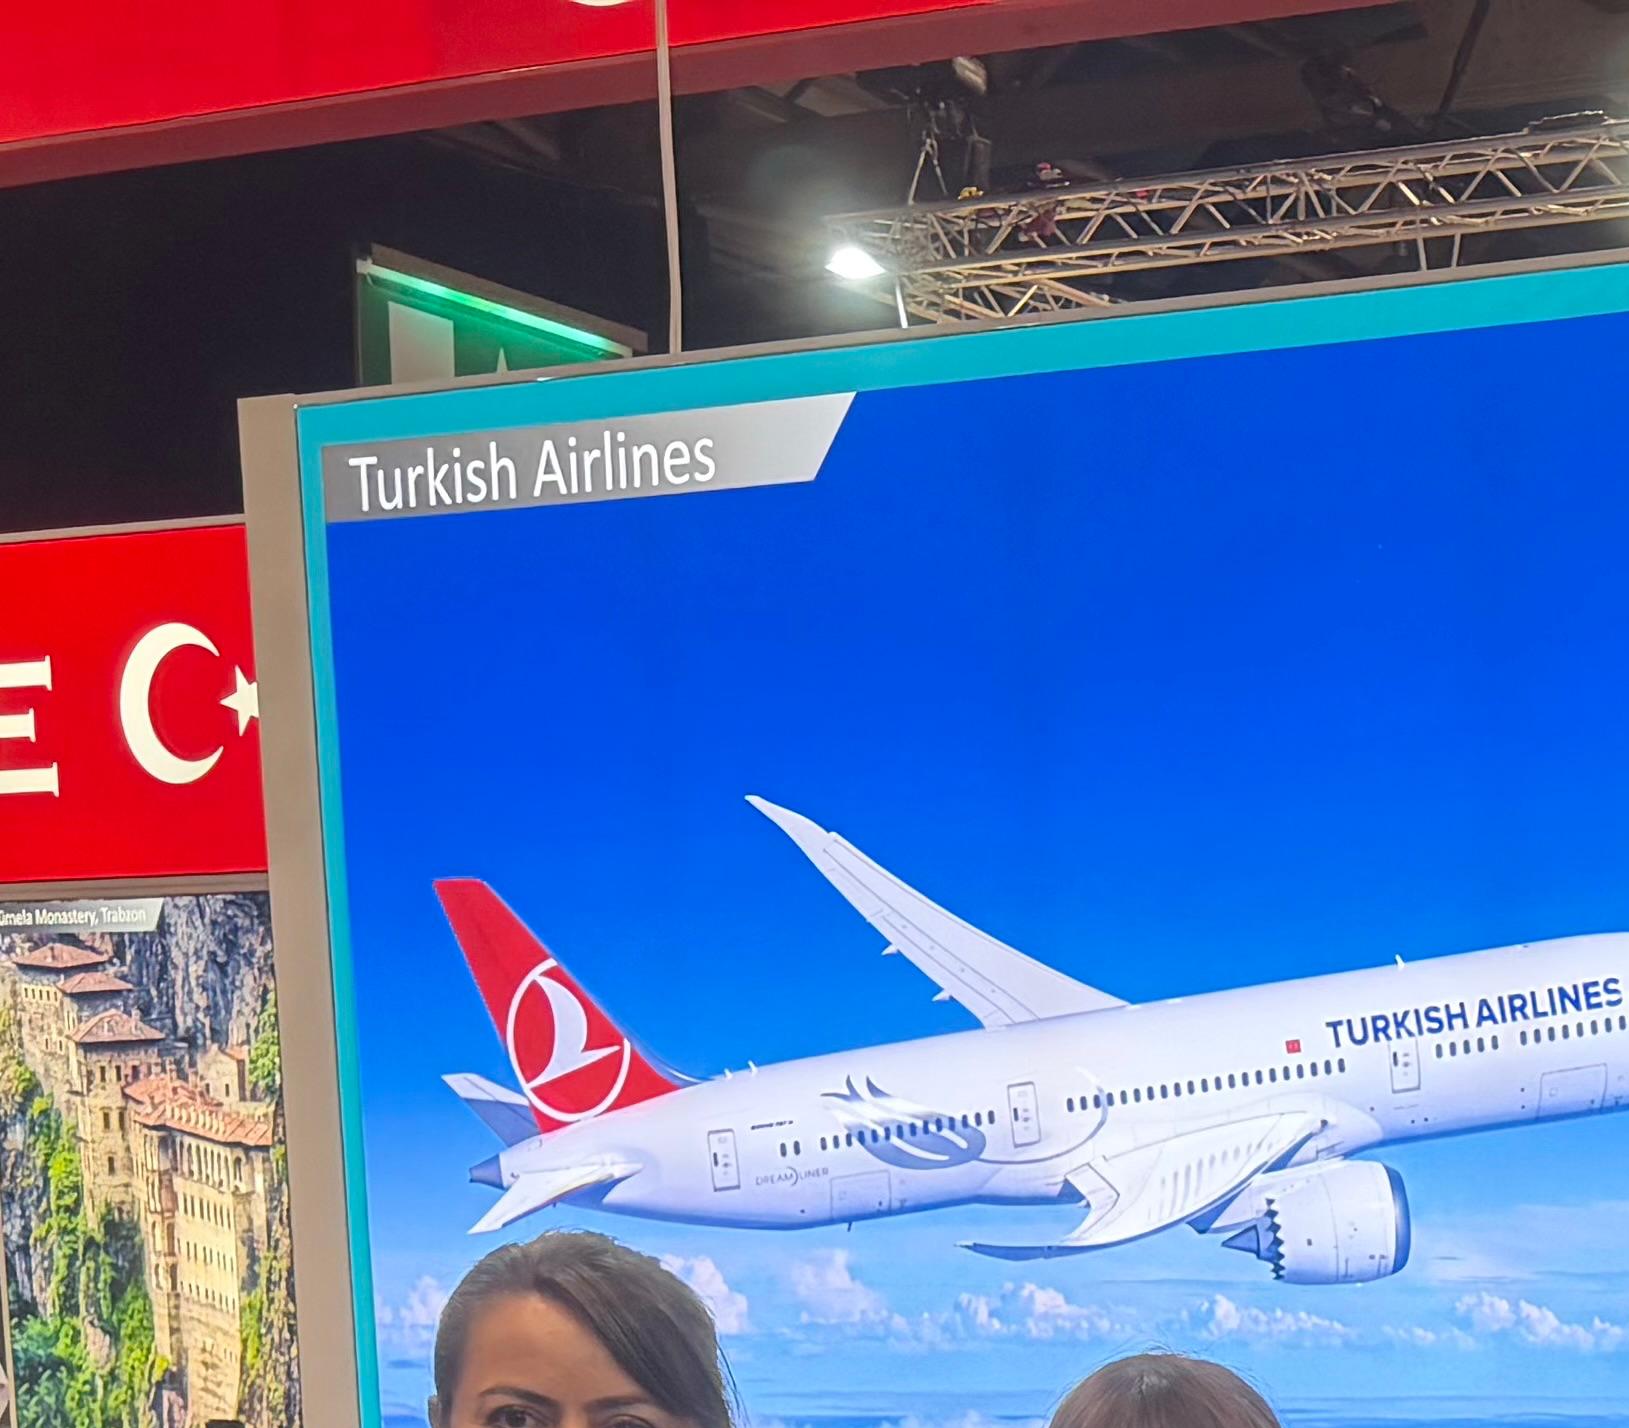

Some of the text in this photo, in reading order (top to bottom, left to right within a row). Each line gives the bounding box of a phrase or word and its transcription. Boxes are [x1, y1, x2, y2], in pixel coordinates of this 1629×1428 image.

[349, 430, 716, 512] Turkish Airlines
[35, 909, 98, 927] Monastery,
[100, 907, 146, 923] Trabzon
[1326, 977, 1623, 1048] TURKISH AIRLINES
